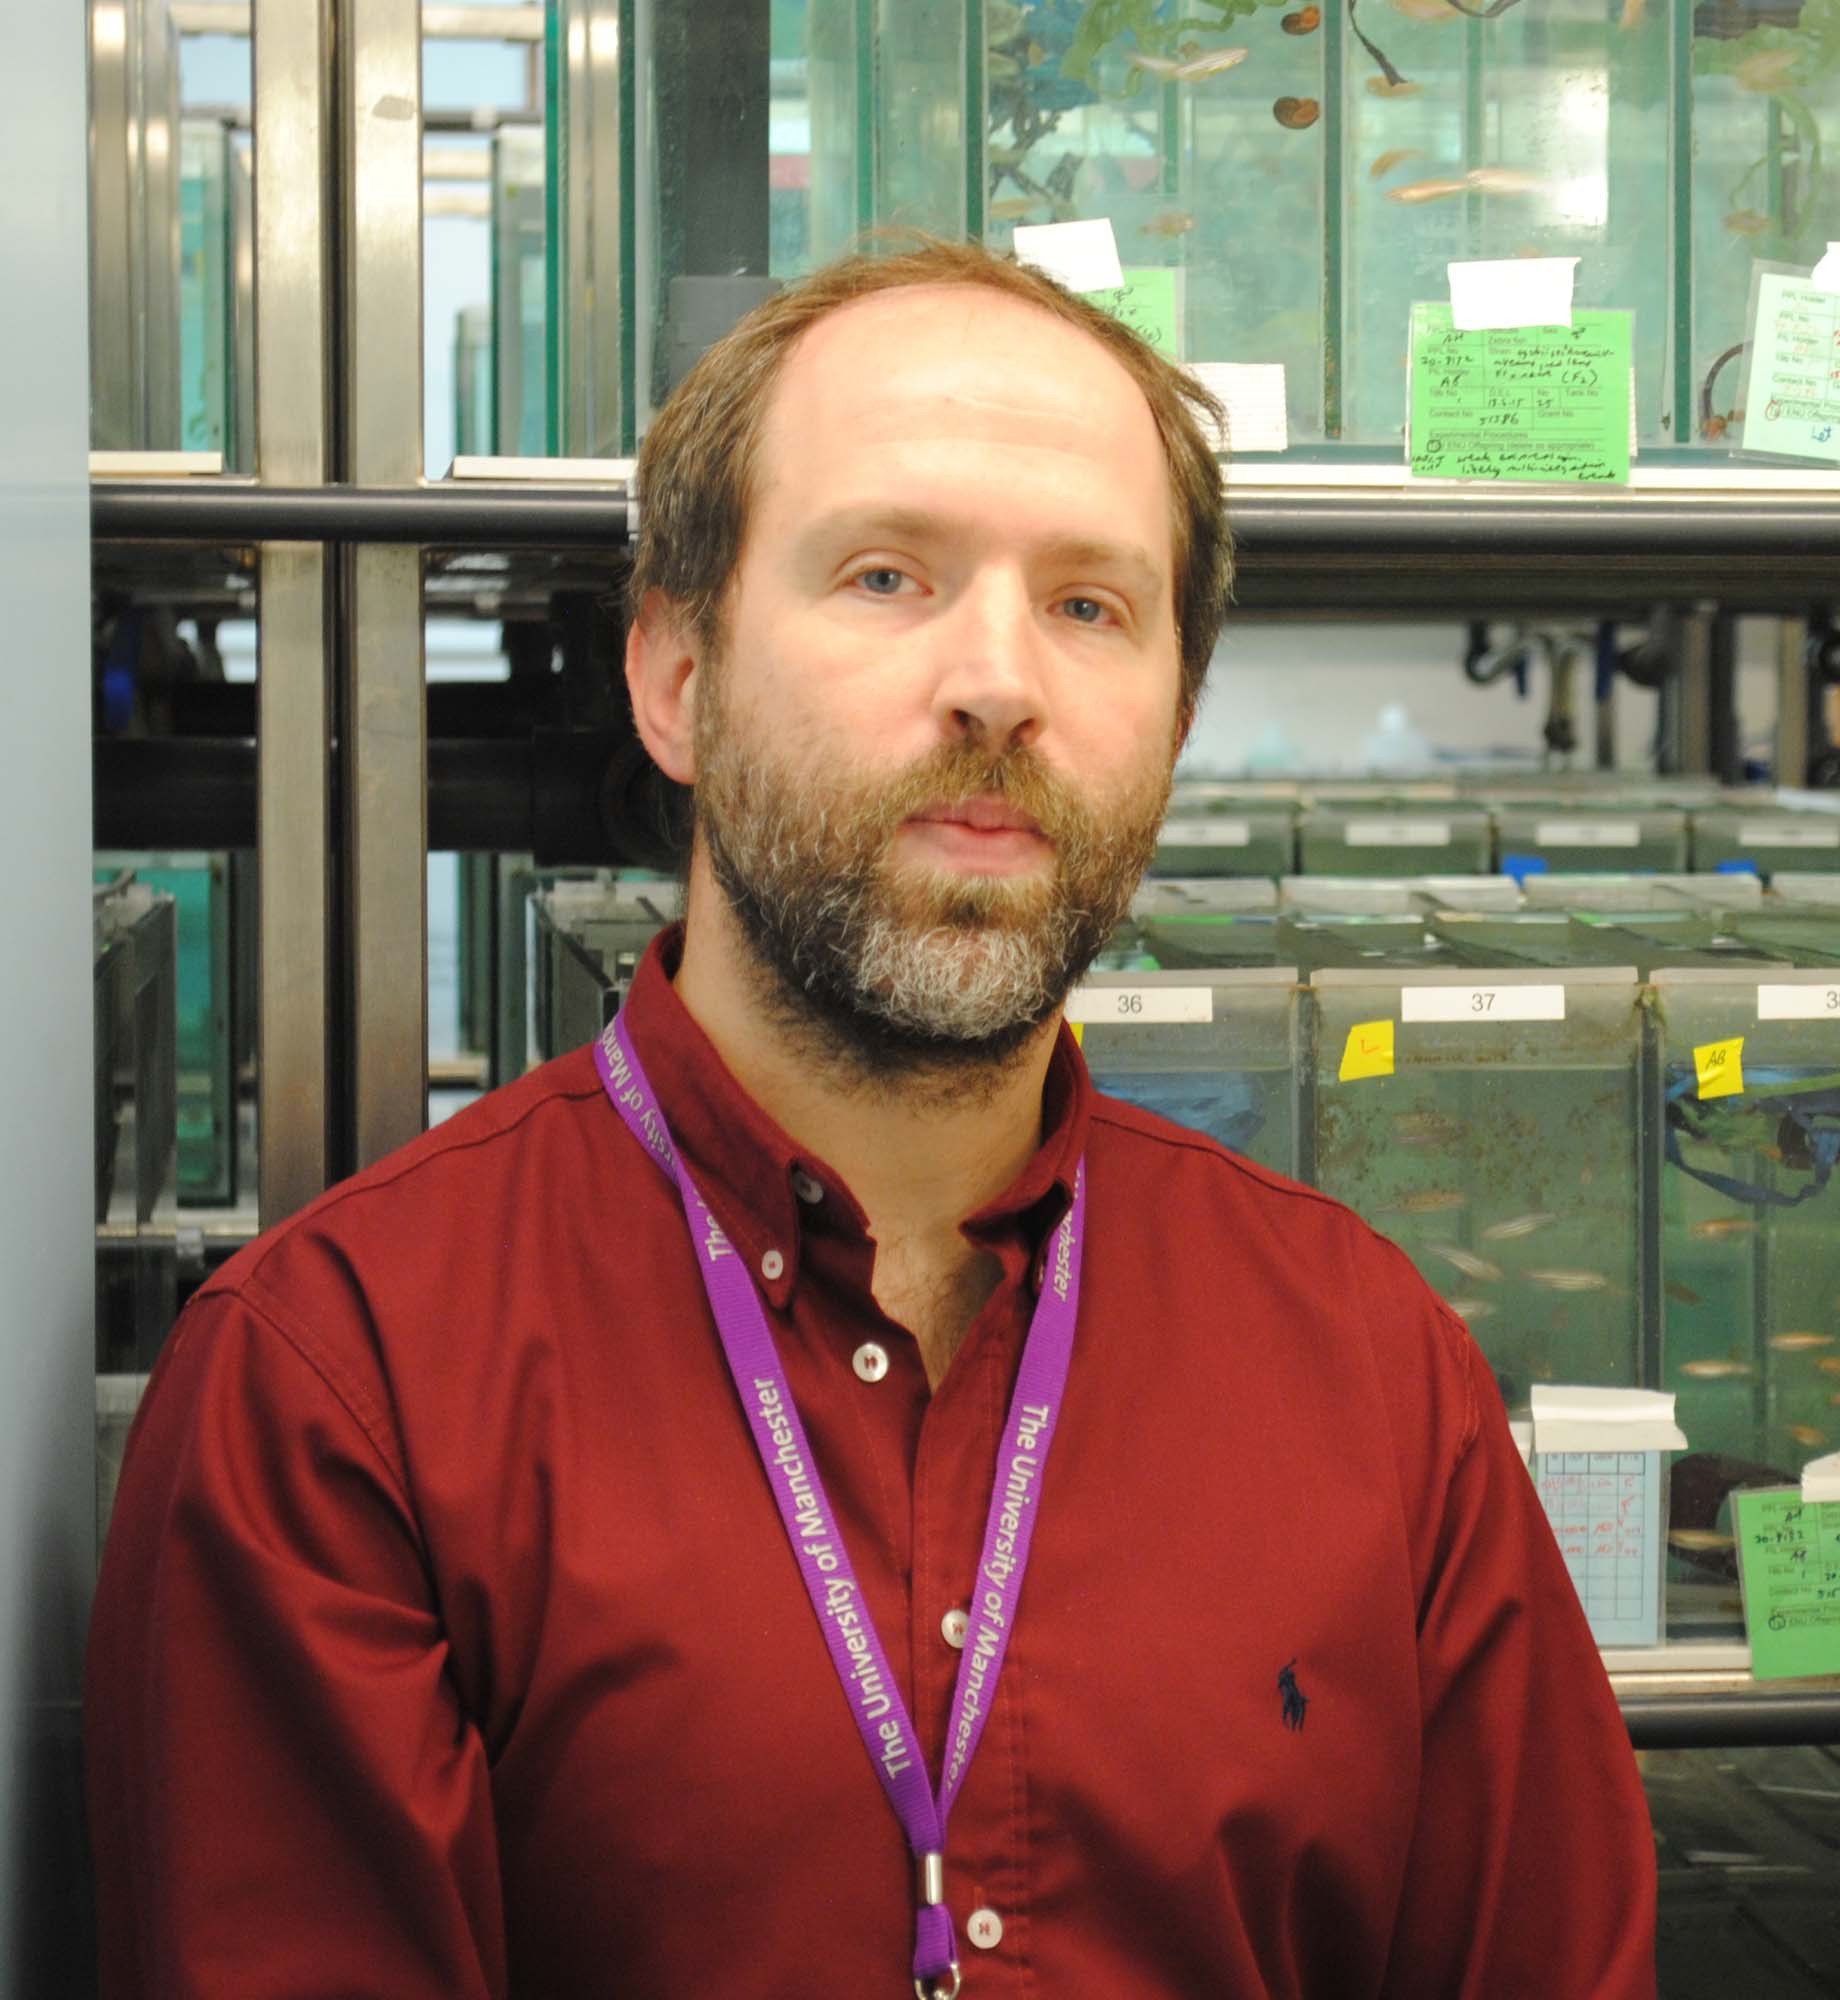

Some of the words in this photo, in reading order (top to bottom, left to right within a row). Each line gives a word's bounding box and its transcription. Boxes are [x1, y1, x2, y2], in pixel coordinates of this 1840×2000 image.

[1117, 993, 1143, 1015] 36
[1471, 992, 1496, 1013] 37
[619, 1084, 643, 1112] of
[704, 1214, 734, 1262] The
[1016, 1403, 1050, 1451] The
[753, 1377, 828, 1539] Manchester
[983, 1454, 1039, 1590] University
[803, 1543, 839, 1573] of
[982, 1591, 1006, 1629] of
[824, 1576, 892, 1721] University
[945, 1622, 1001, 1791] Manchester
[877, 1718, 911, 1781] The
